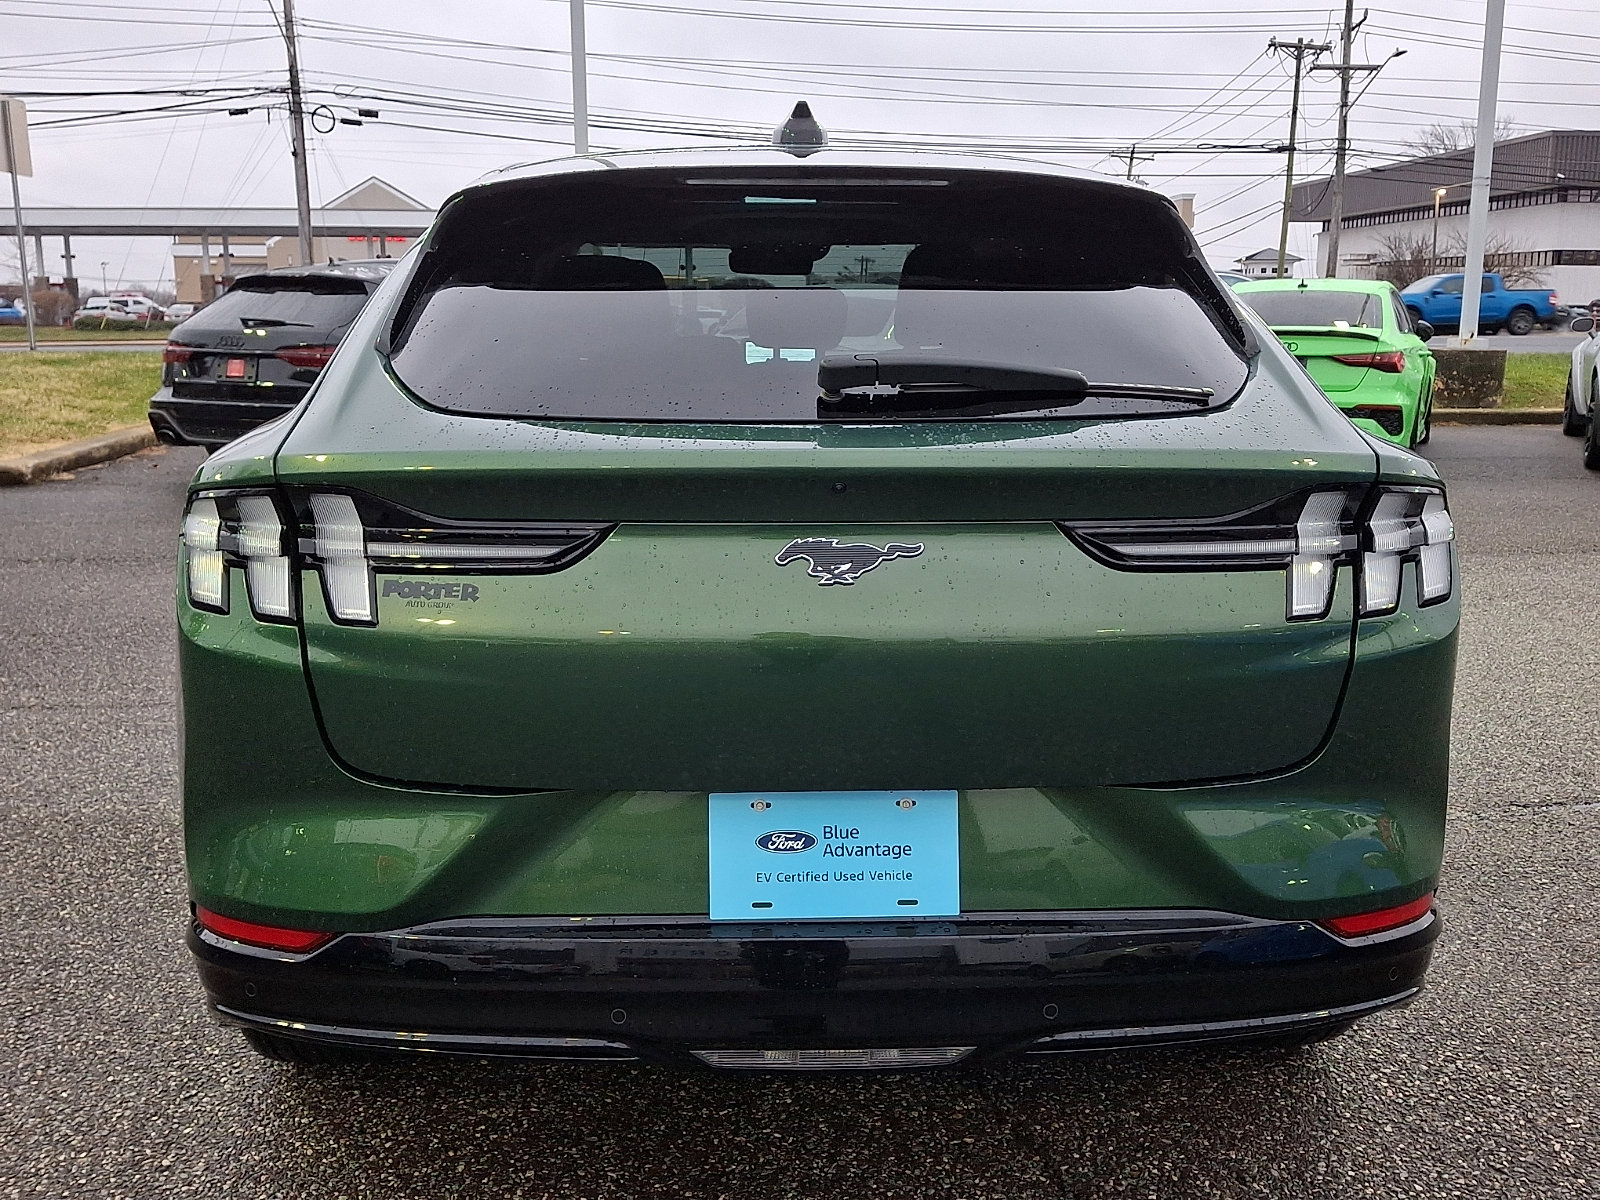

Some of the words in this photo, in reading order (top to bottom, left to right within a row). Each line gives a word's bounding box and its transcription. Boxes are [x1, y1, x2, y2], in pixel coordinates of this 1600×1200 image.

[382, 579, 480, 602] PORTER
[405, 601, 426, 609] AUTO
[823, 825, 860, 840] Blue
[767, 832, 806, 851] Ford
[823, 842, 912, 860] Advantage
[756, 872, 772, 883] EV
[776, 871, 829, 883] Certified
[833, 870, 865, 882] Used
[869, 870, 913, 882] Vehicle
